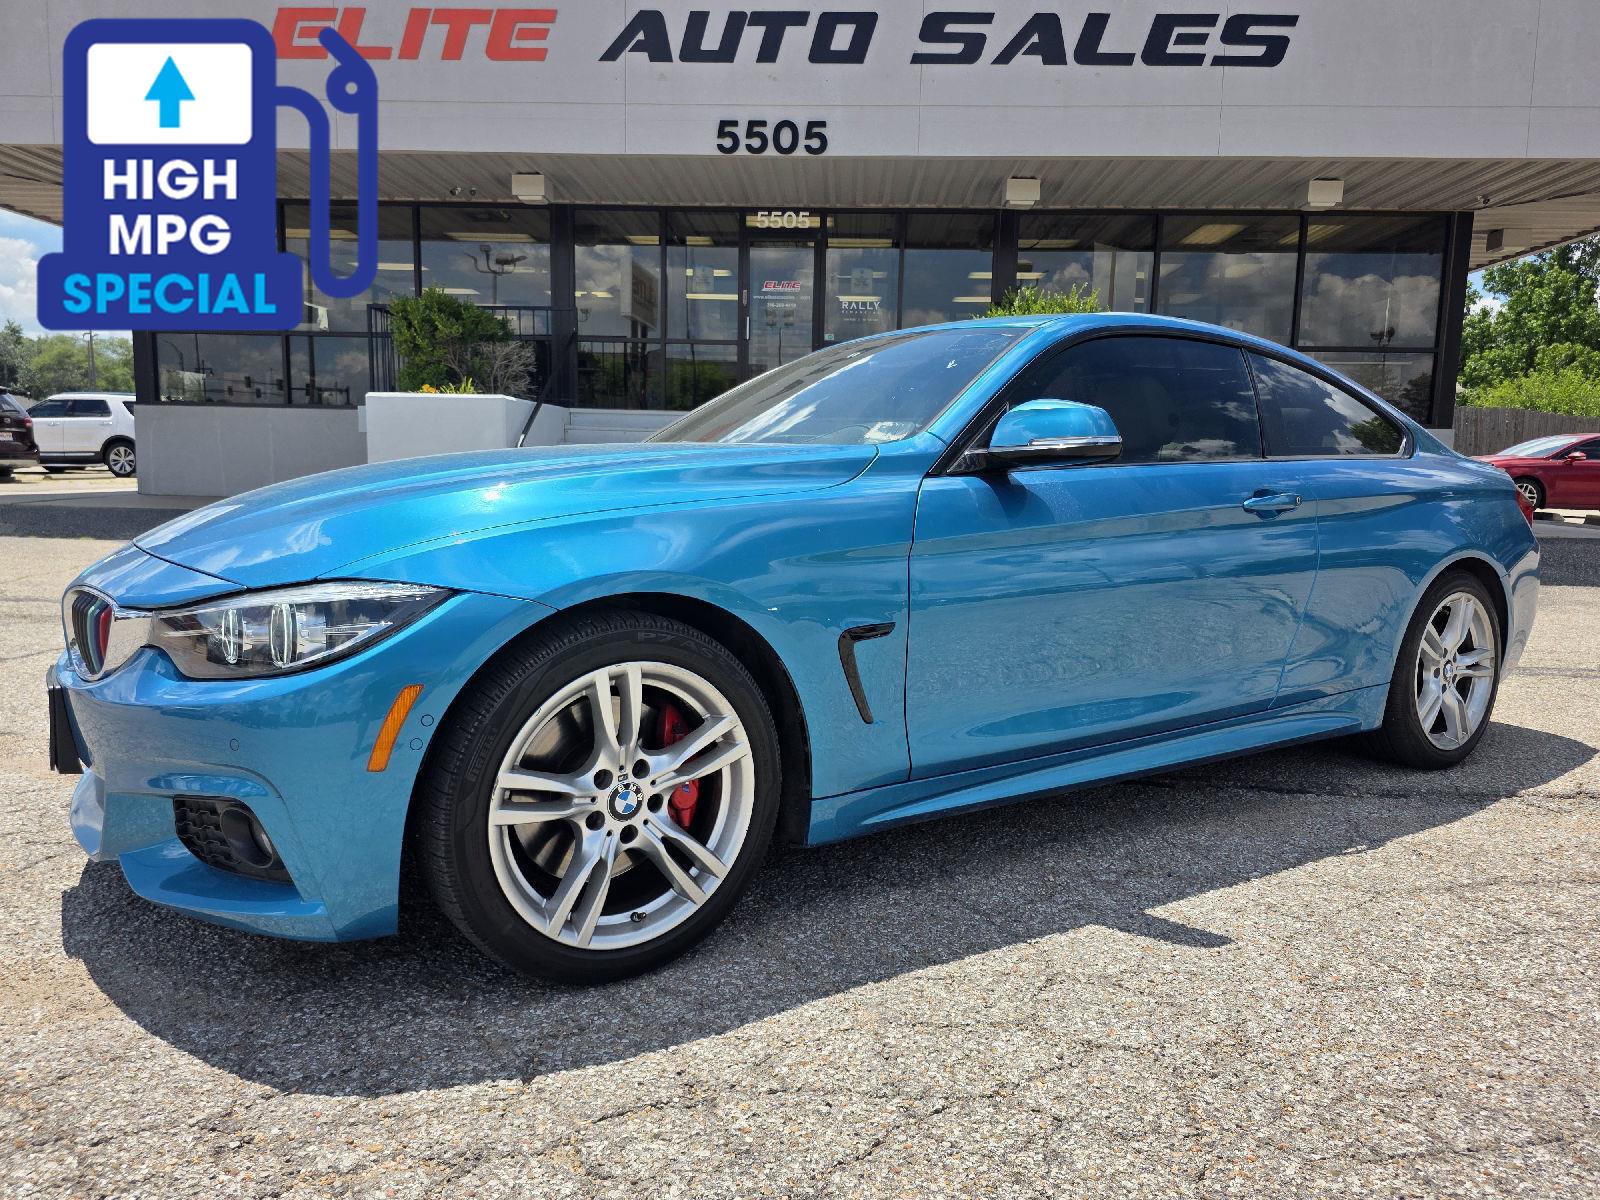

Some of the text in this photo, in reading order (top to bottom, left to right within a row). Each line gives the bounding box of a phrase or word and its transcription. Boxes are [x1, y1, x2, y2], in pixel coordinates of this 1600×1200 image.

[272, 7, 1300, 68] ELITE AUTO SALES
[715, 119, 829, 155] 5505
[756, 211, 811, 229] 5505
[763, 280, 801, 289] ELITE
[841, 301, 881, 310] RALLY
